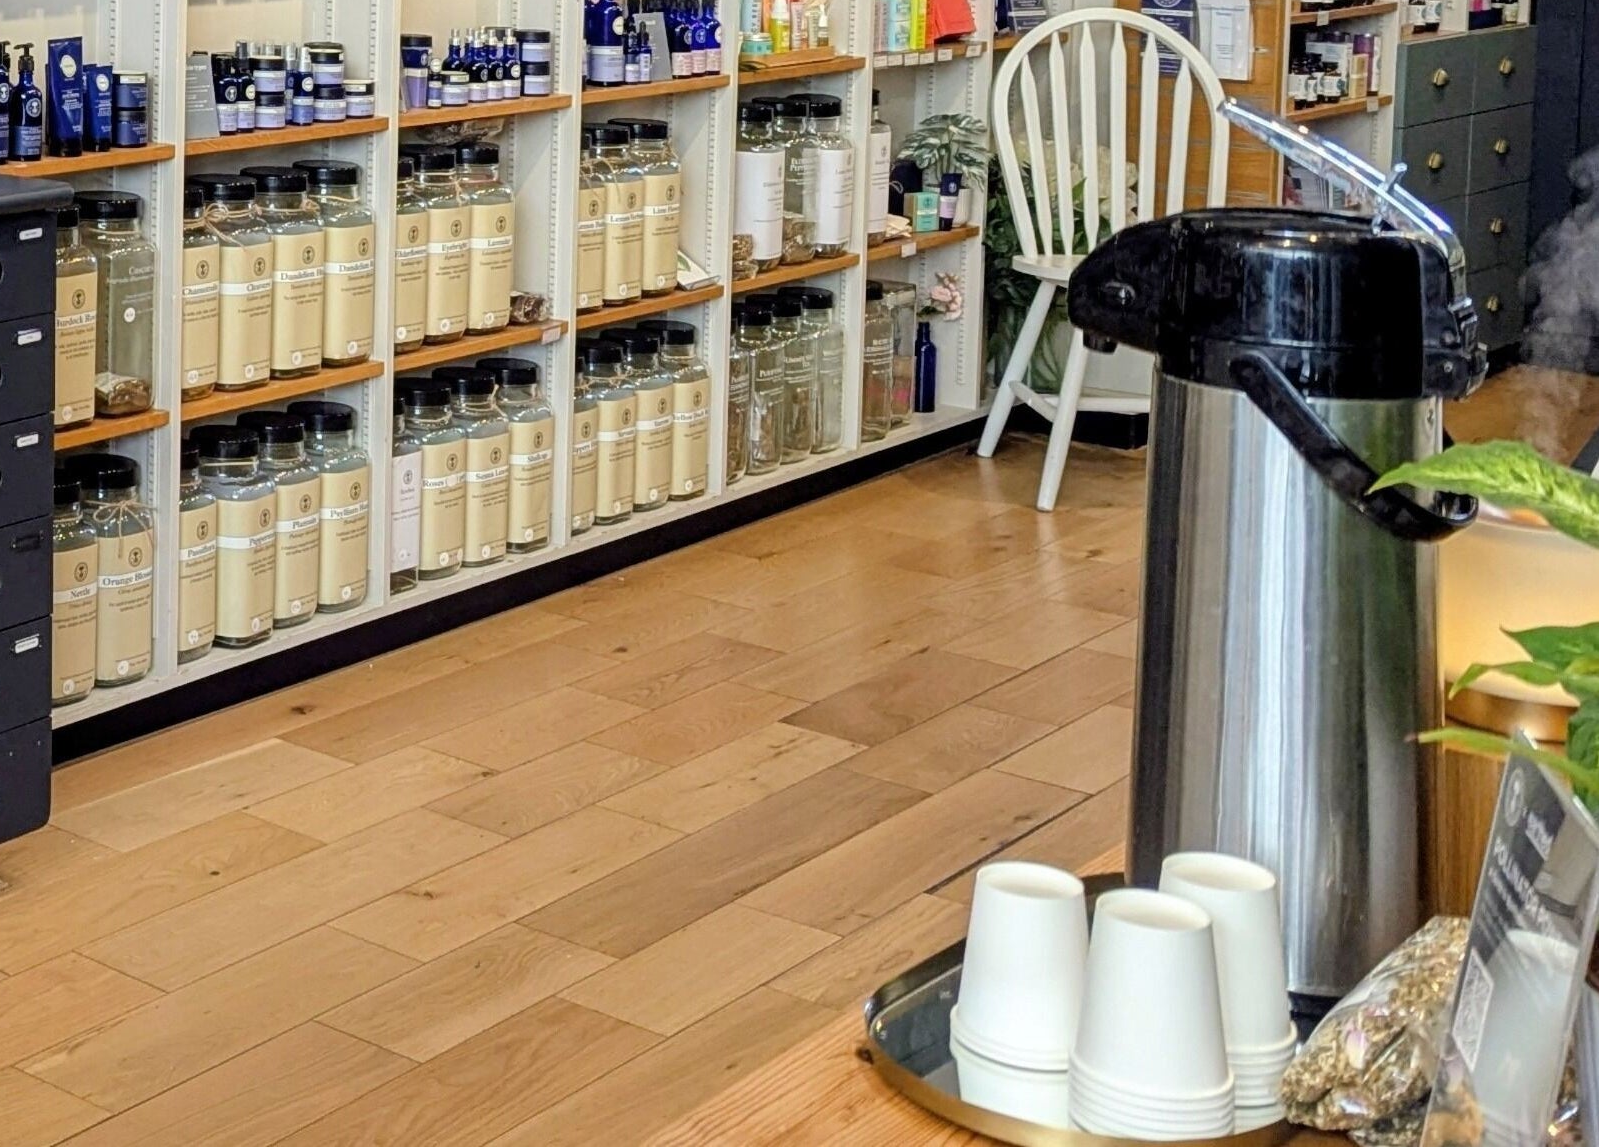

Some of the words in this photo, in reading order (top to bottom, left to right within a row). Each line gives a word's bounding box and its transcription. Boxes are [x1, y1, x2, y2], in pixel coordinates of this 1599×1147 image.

[339, 262, 369, 272] Dandelion
[280, 270, 315, 281] Dandelion
[423, 479, 444, 487] Roses
[103, 575, 133, 586] Orange
[70, 588, 91, 599] Nettle
